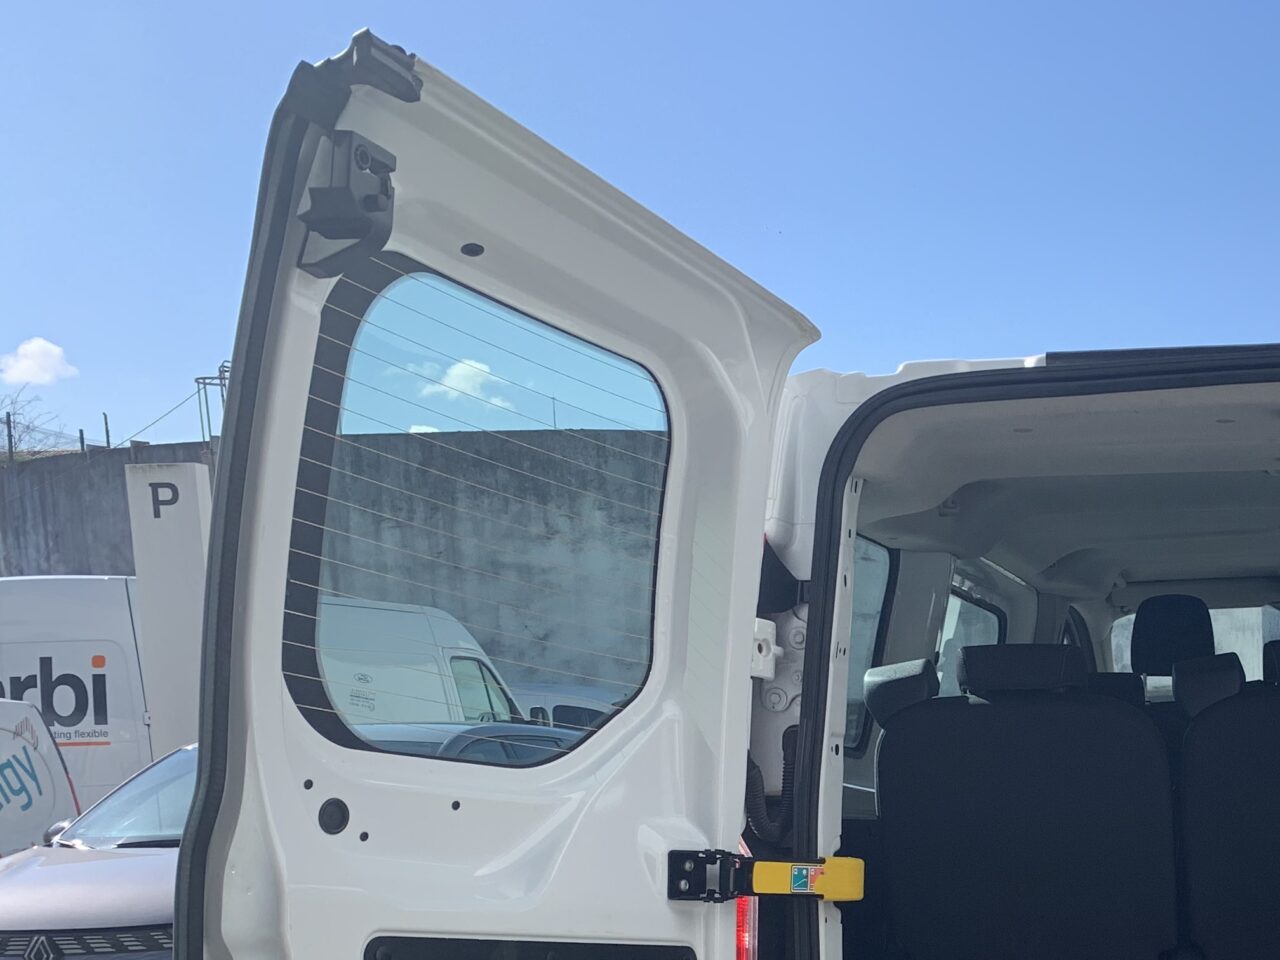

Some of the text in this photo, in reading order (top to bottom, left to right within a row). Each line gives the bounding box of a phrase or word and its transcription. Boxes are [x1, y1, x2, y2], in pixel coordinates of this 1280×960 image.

[148, 482, 179, 519] P
[0, 655, 108, 728] rbi
[74, 728, 109, 739] flexible
